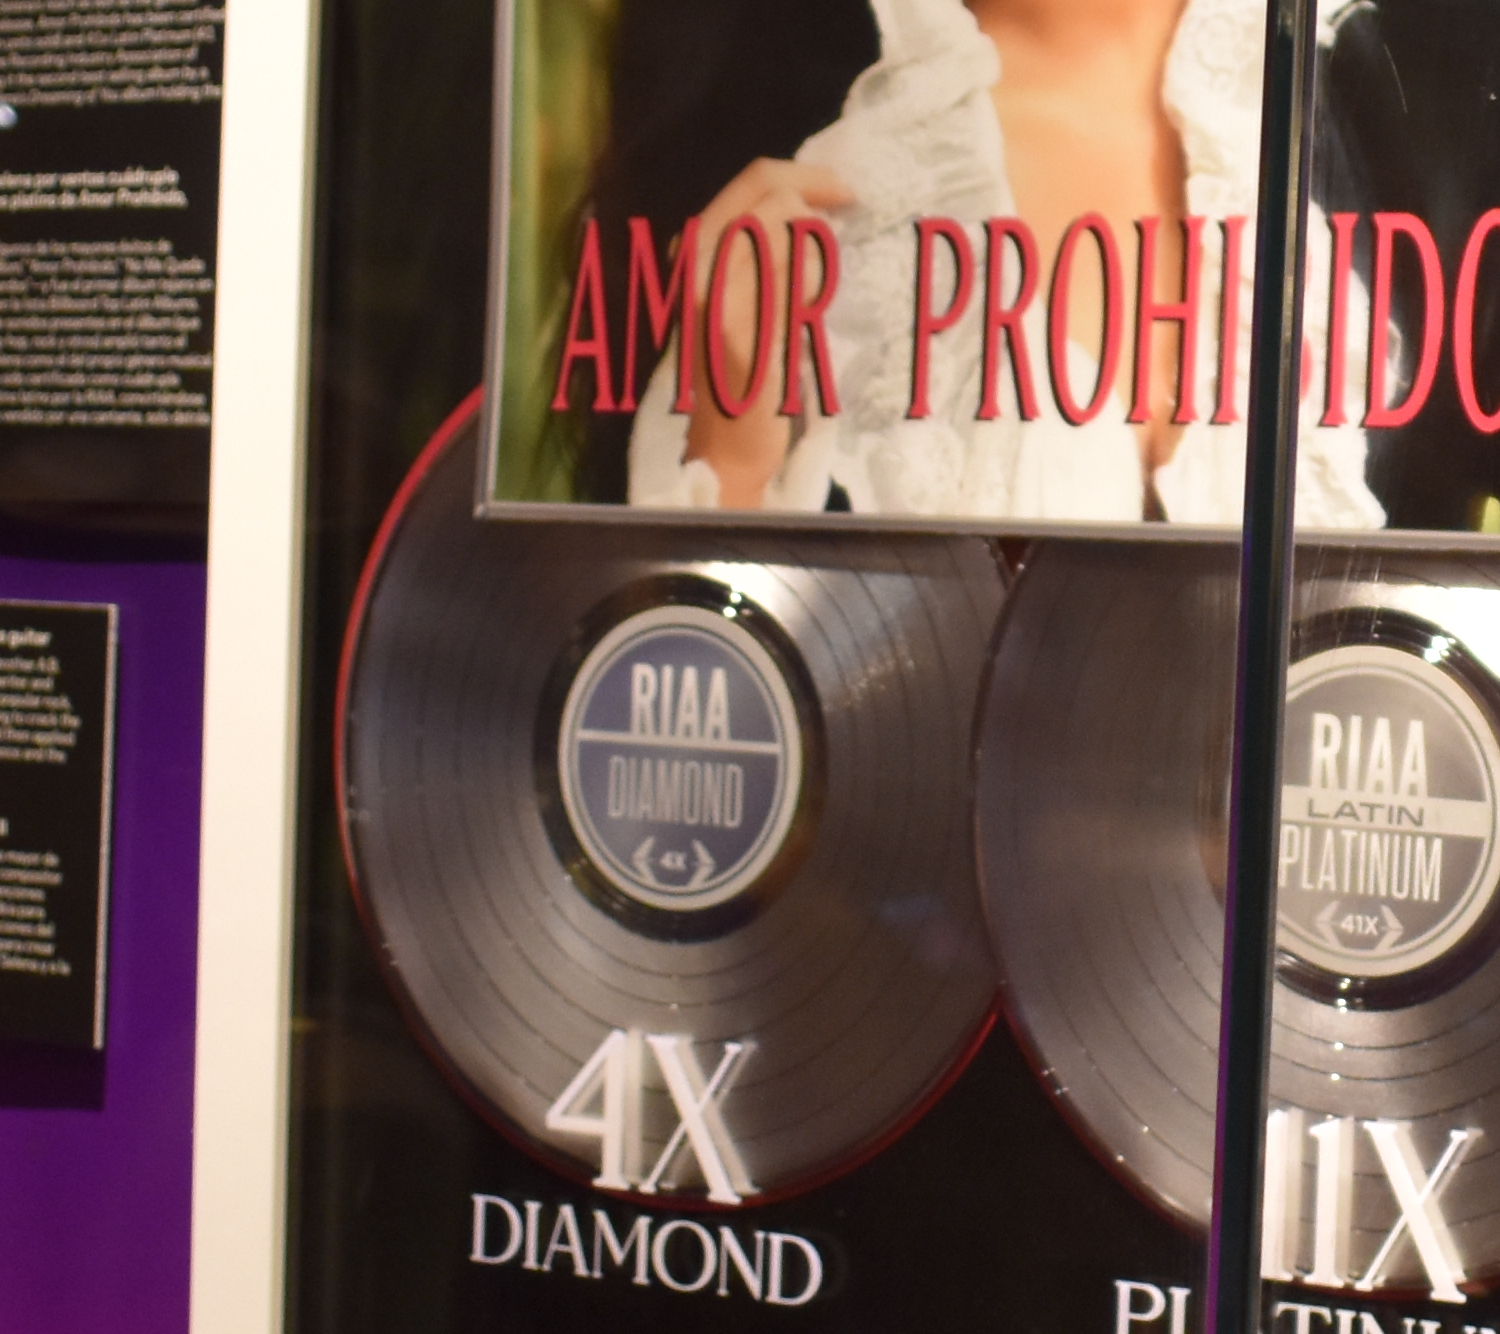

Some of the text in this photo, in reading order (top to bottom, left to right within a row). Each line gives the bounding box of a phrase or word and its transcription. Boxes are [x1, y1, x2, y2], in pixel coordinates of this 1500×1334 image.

[551, 214, 842, 421] AMOR
[630, 663, 731, 741] RIAA
[607, 754, 745, 829] DIAMOND
[1310, 712, 1429, 798] RIAA
[1306, 798, 1425, 828] LATIN
[659, 850, 687, 871] 4X
[1279, 824, 1443, 902] PLATINUM
[1339, 913, 1380, 937] 41X
[545, 1029, 745, 1206] 4X
[468, 1192, 825, 1307] DIAMOND
